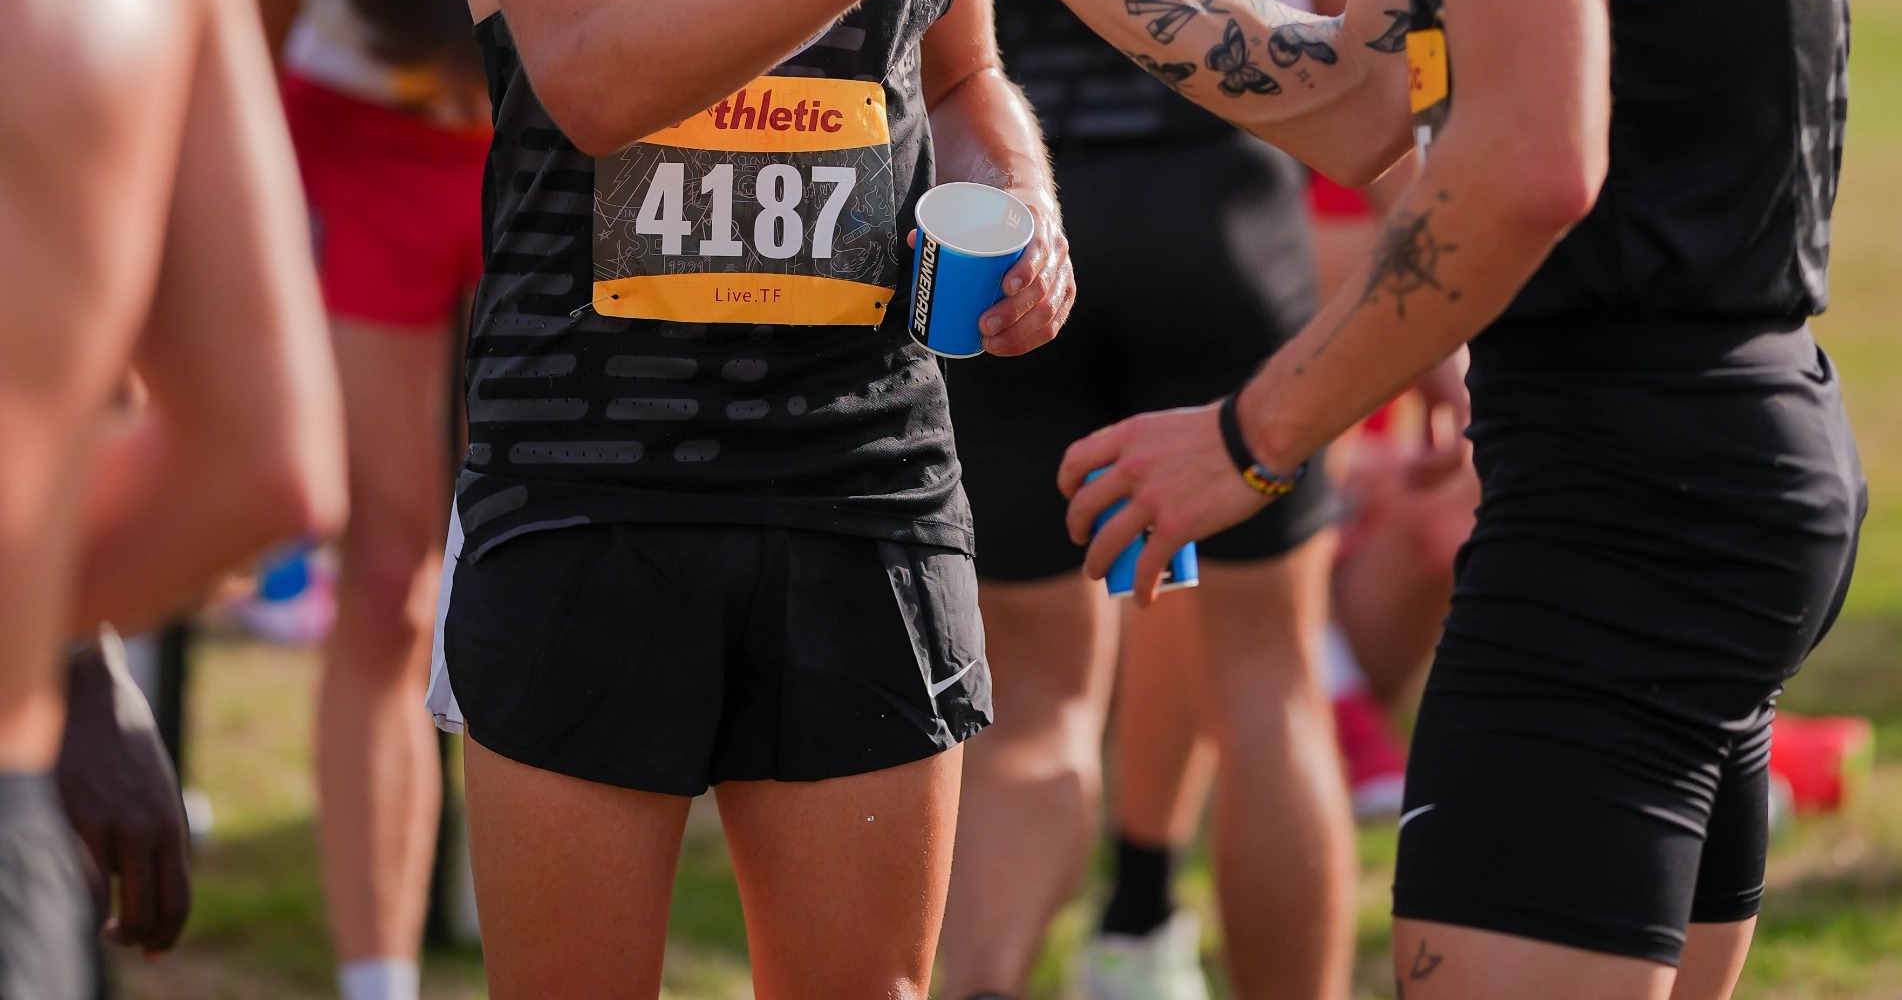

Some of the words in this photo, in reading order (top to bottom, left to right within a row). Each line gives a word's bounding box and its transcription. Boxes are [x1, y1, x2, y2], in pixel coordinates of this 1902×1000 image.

[706, 88, 843, 133] thletic
[635, 162, 857, 259] 4187
[714, 287, 782, 304] Live.TF
[913, 234, 937, 336] POWERADE
